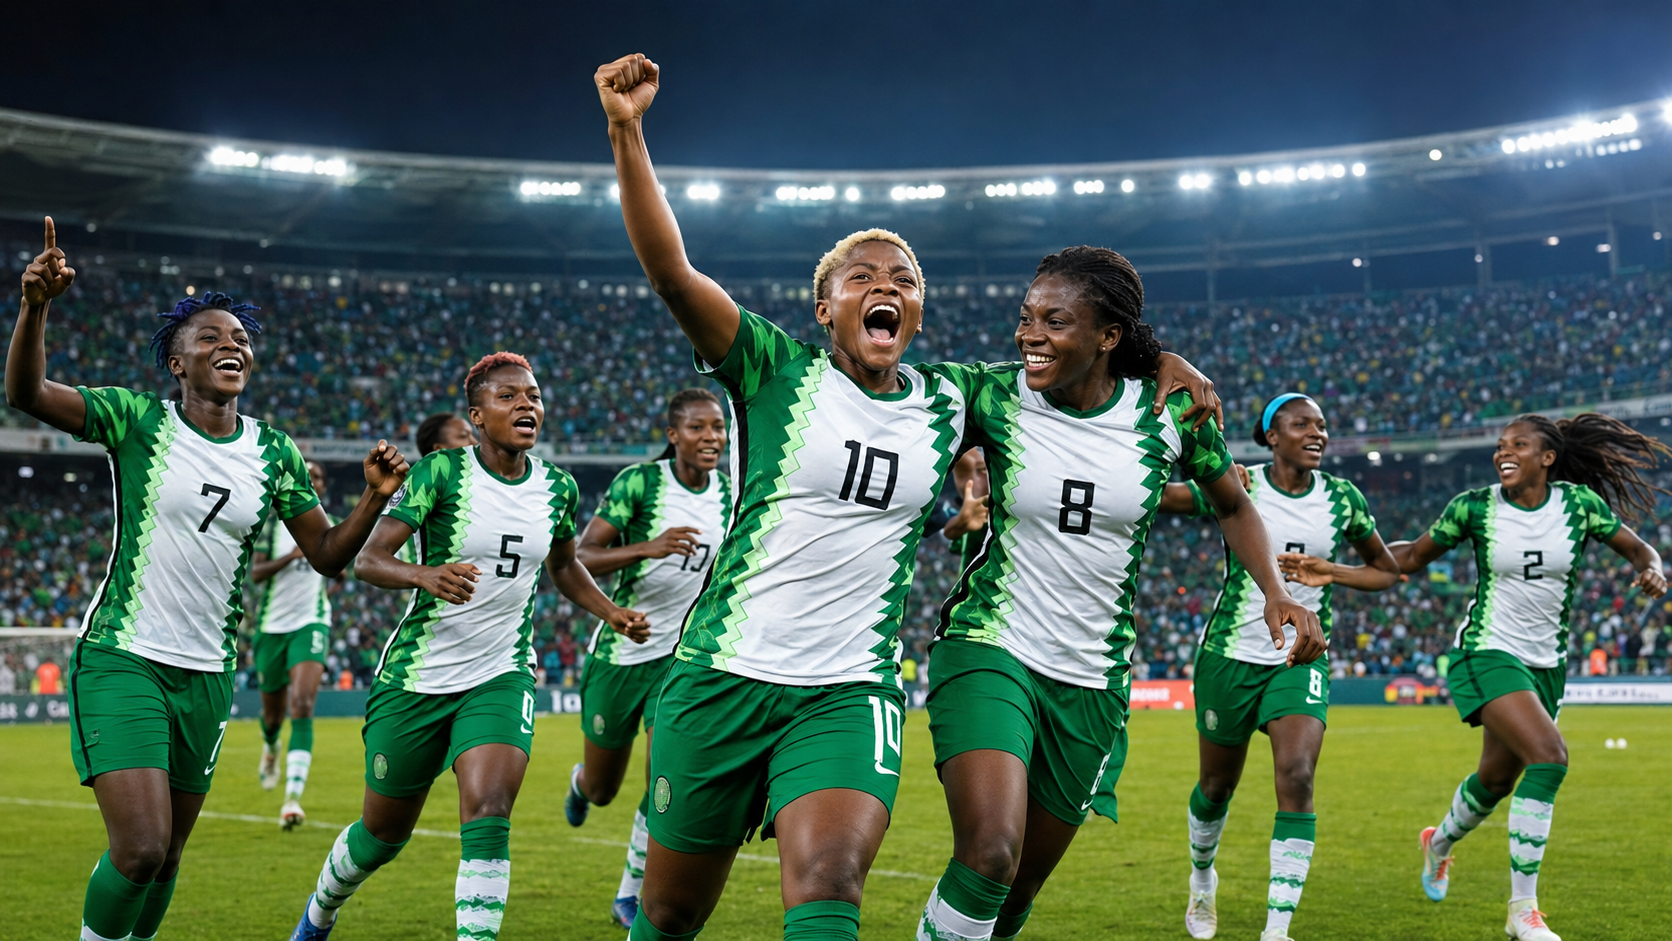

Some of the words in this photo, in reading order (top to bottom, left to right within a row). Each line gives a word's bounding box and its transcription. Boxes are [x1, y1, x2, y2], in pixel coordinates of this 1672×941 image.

[838, 440, 899, 511] 10
[197, 483, 231, 533] 7
[1058, 479, 1096, 535] 8
[495, 535, 524, 578] 5
[1523, 550, 1543, 580] 2
[1309, 668, 1323, 698] 8
[209, 721, 228, 763] 7
[867, 695, 901, 763] 10
[1090, 752, 1111, 795] 8
